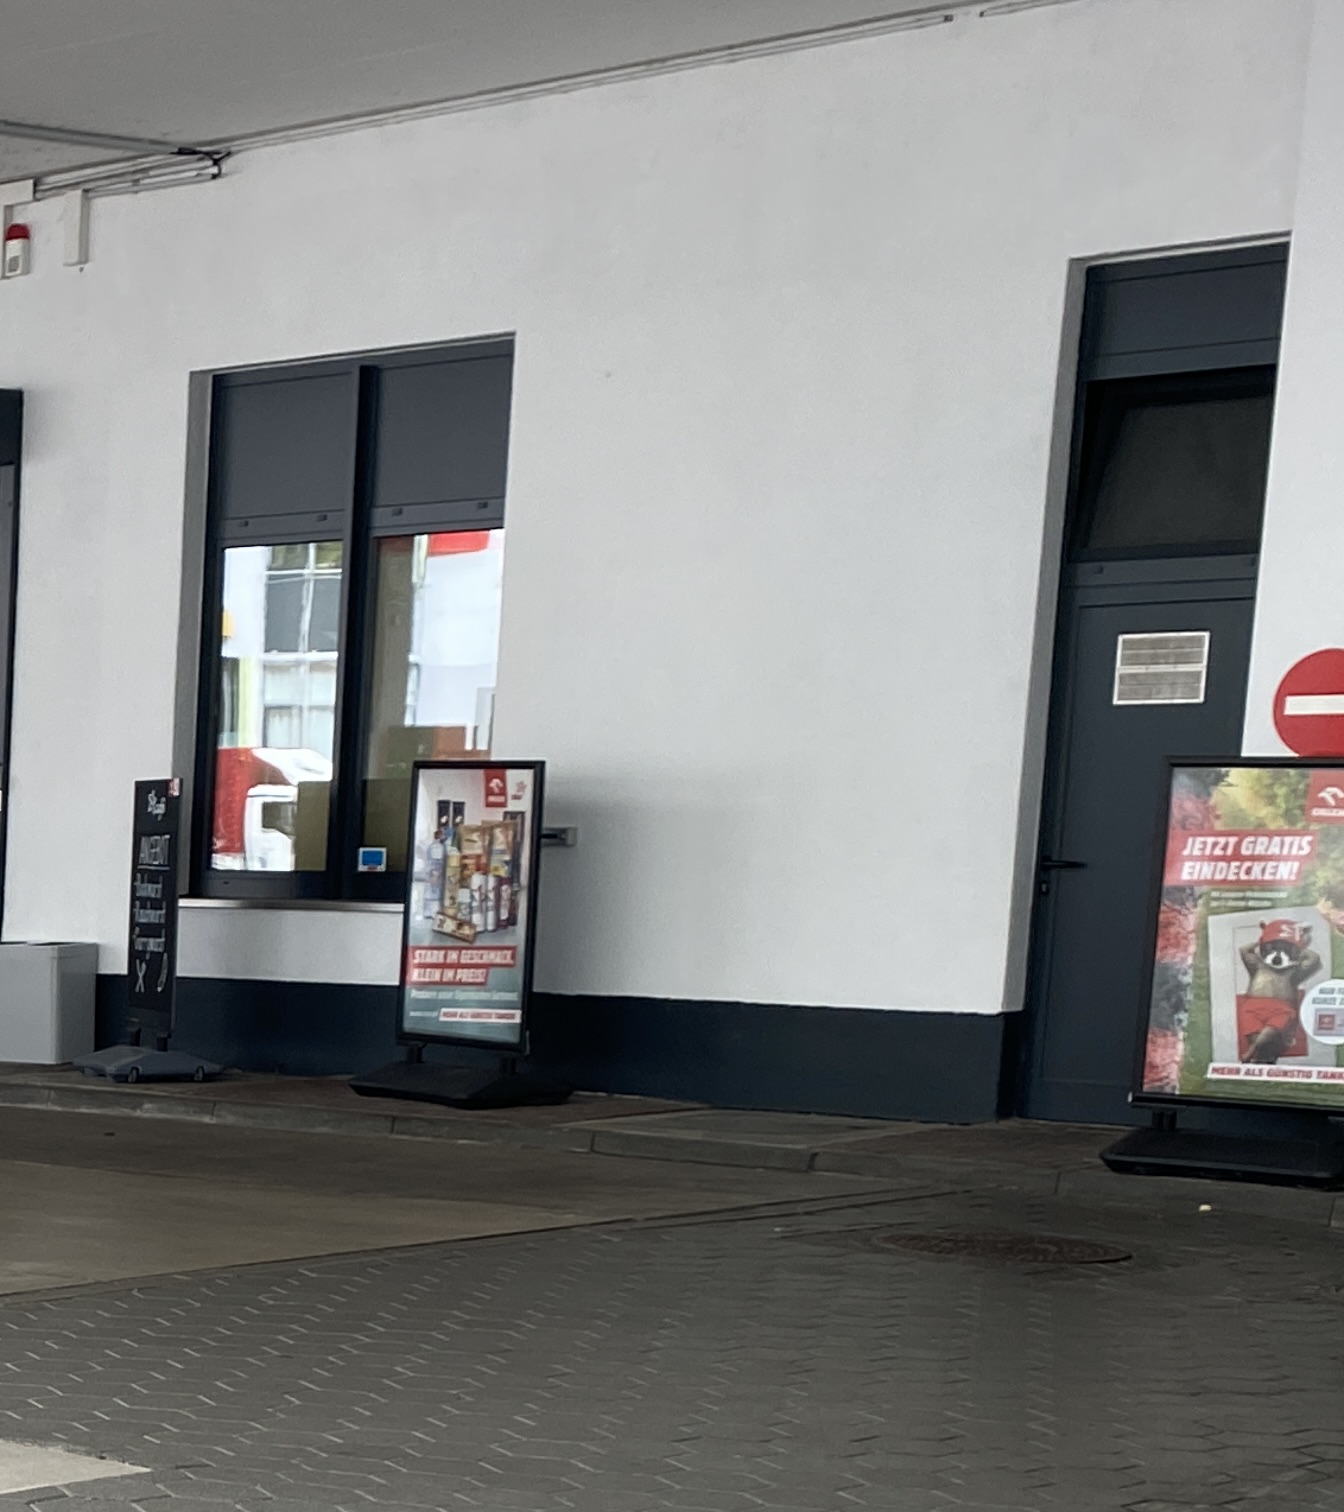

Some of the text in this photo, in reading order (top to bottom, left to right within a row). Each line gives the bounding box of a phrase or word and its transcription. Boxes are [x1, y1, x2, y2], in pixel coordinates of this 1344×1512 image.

[1182, 835, 1313, 856] JETZT GRATIS
[1181, 860, 1301, 881] EINDECKEN!
